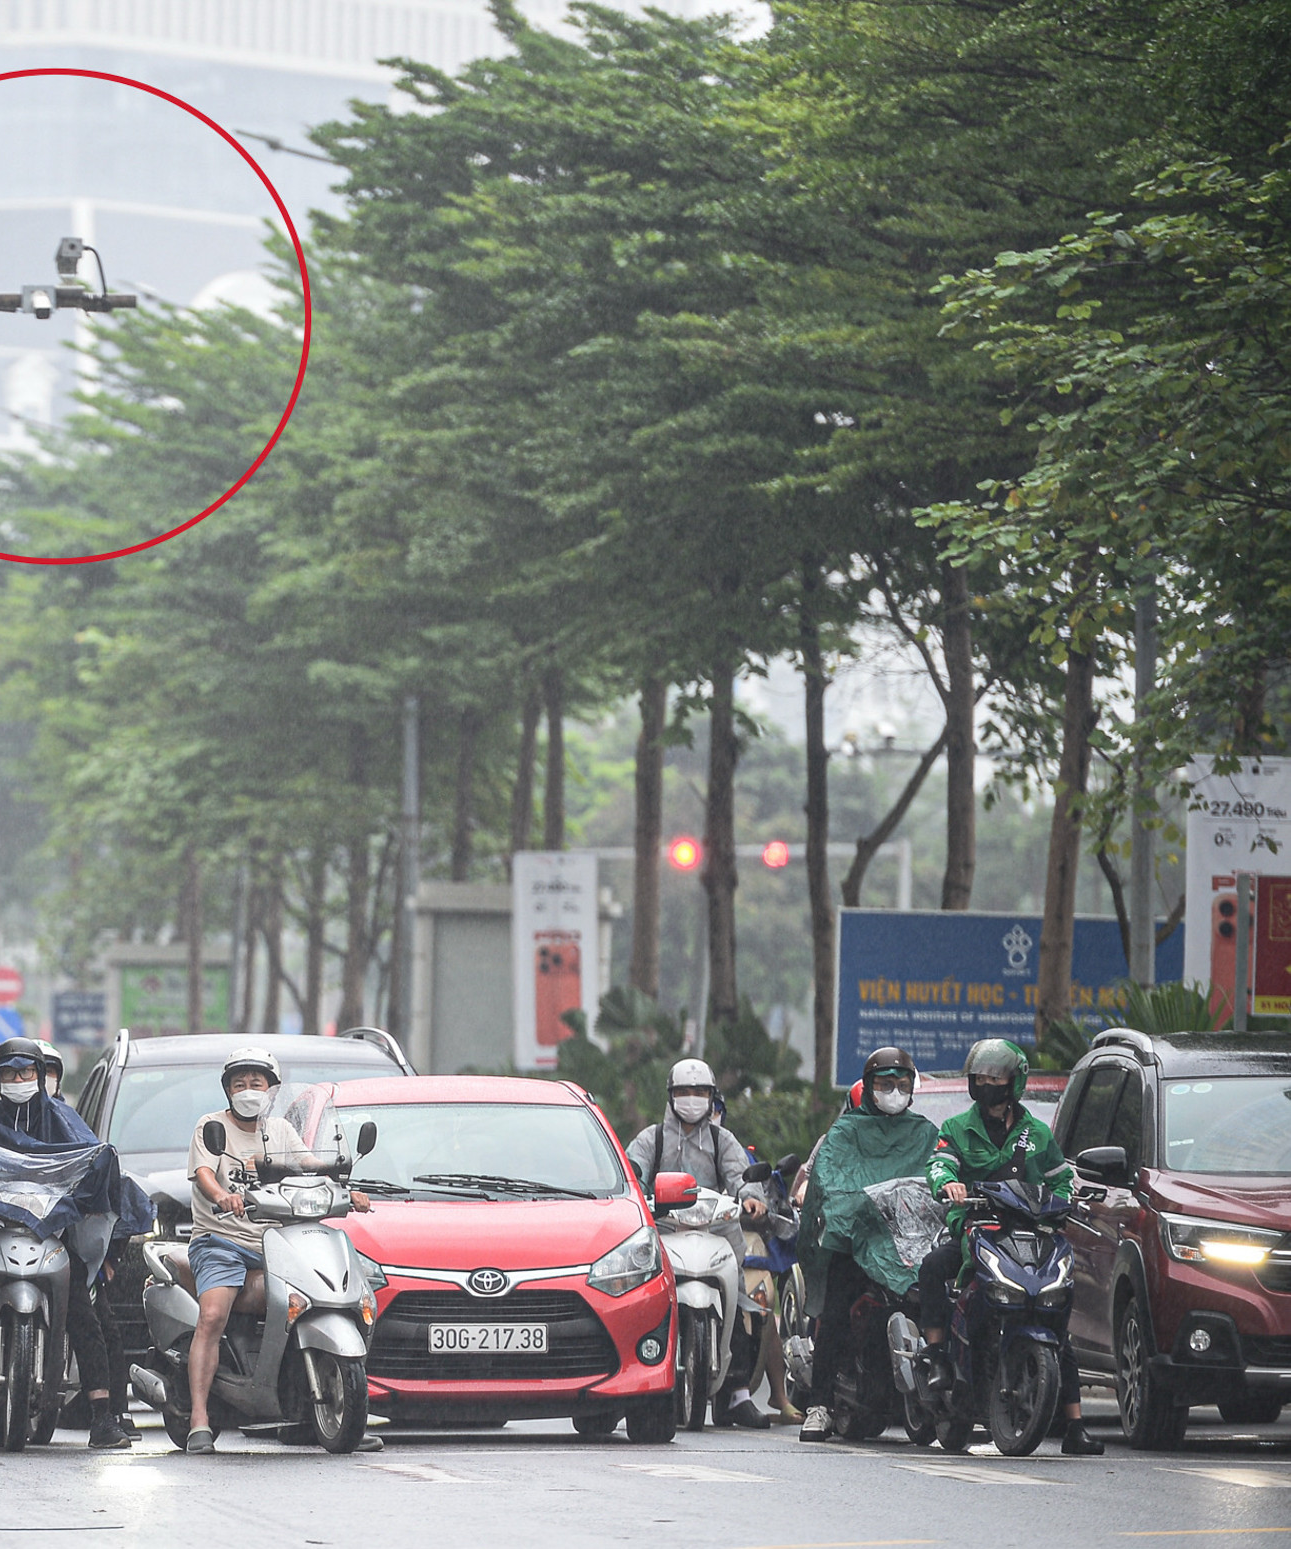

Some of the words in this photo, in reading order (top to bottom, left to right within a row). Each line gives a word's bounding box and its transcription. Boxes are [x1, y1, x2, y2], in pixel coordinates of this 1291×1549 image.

[859, 975, 901, 1007] VIỆN
[906, 974, 963, 1005] HUYẾT
[967, 982, 1005, 1010] HỌC
[433, 1327, 545, 1350] 30G-217.38
